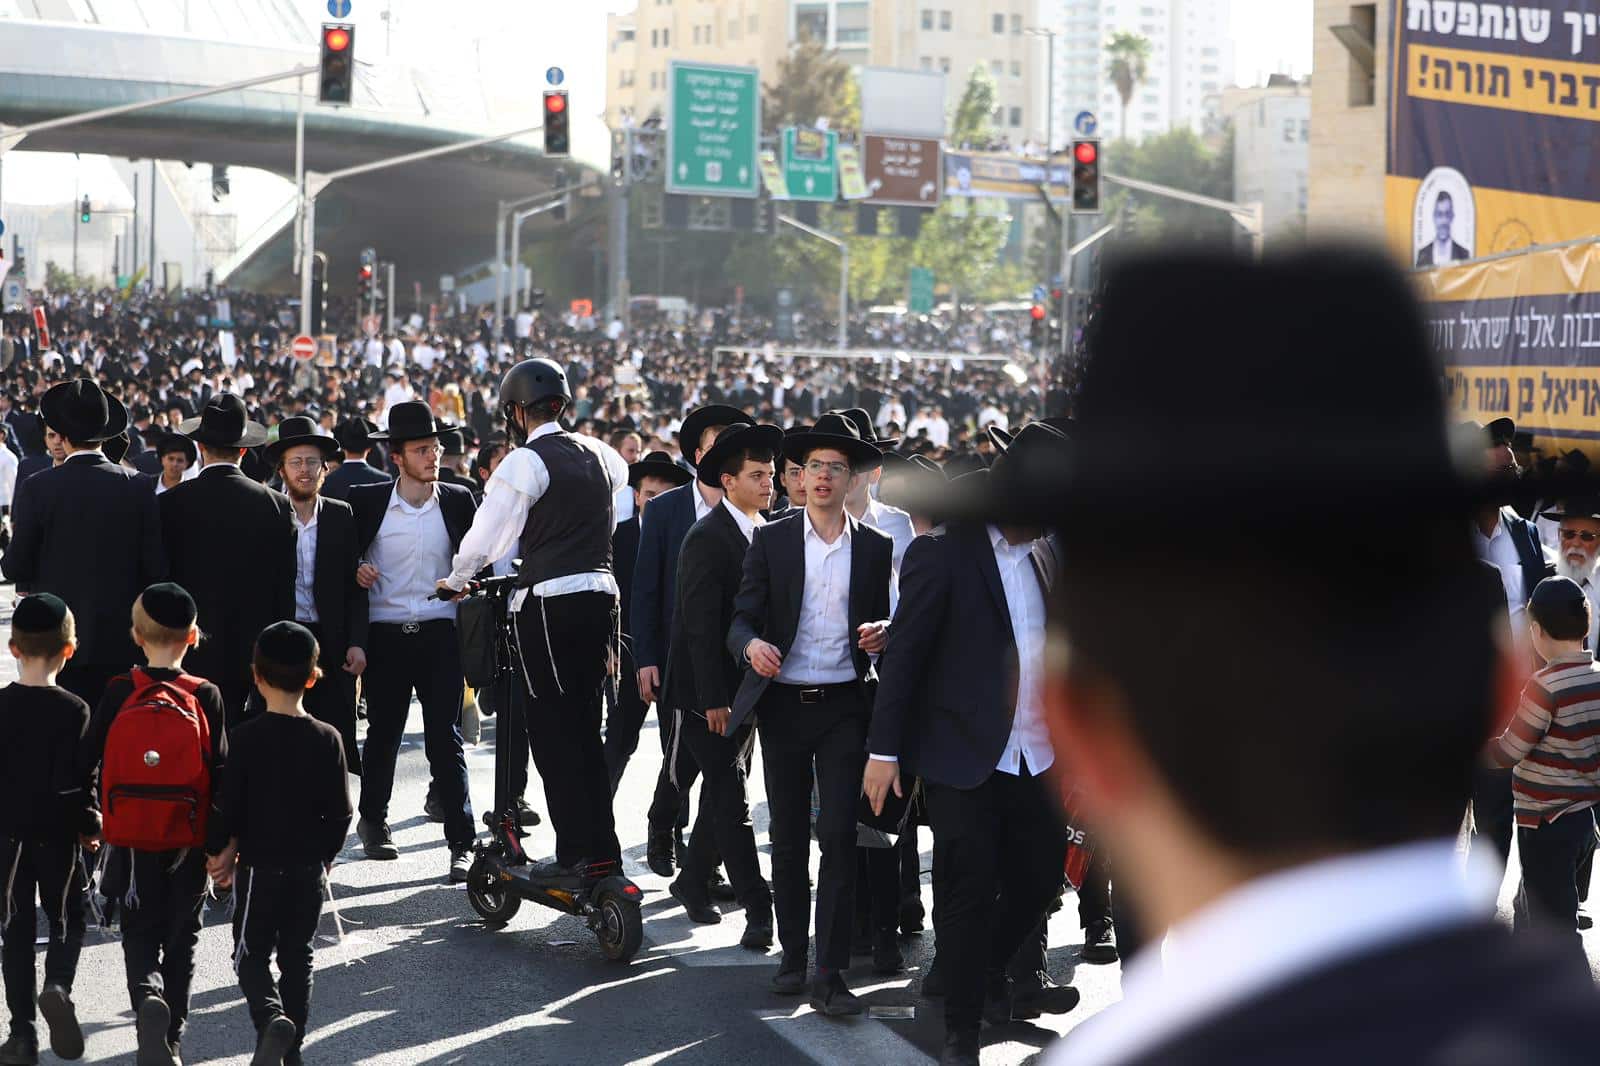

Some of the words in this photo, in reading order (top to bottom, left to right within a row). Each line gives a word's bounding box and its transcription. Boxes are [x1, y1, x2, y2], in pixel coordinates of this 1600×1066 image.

[1407, 0, 1550, 43] שנתפסת
[1563, 11, 1600, 55] יך
[1419, 54, 1509, 98] תורה!
[1523, 69, 1600, 109] דברי
[1461, 311, 1510, 350] ישראל
[1515, 306, 1555, 347] אלפי
[1474, 377, 1510, 412] תמר
[1517, 377, 1534, 419] בן
[1541, 371, 1600, 416] אריאל
